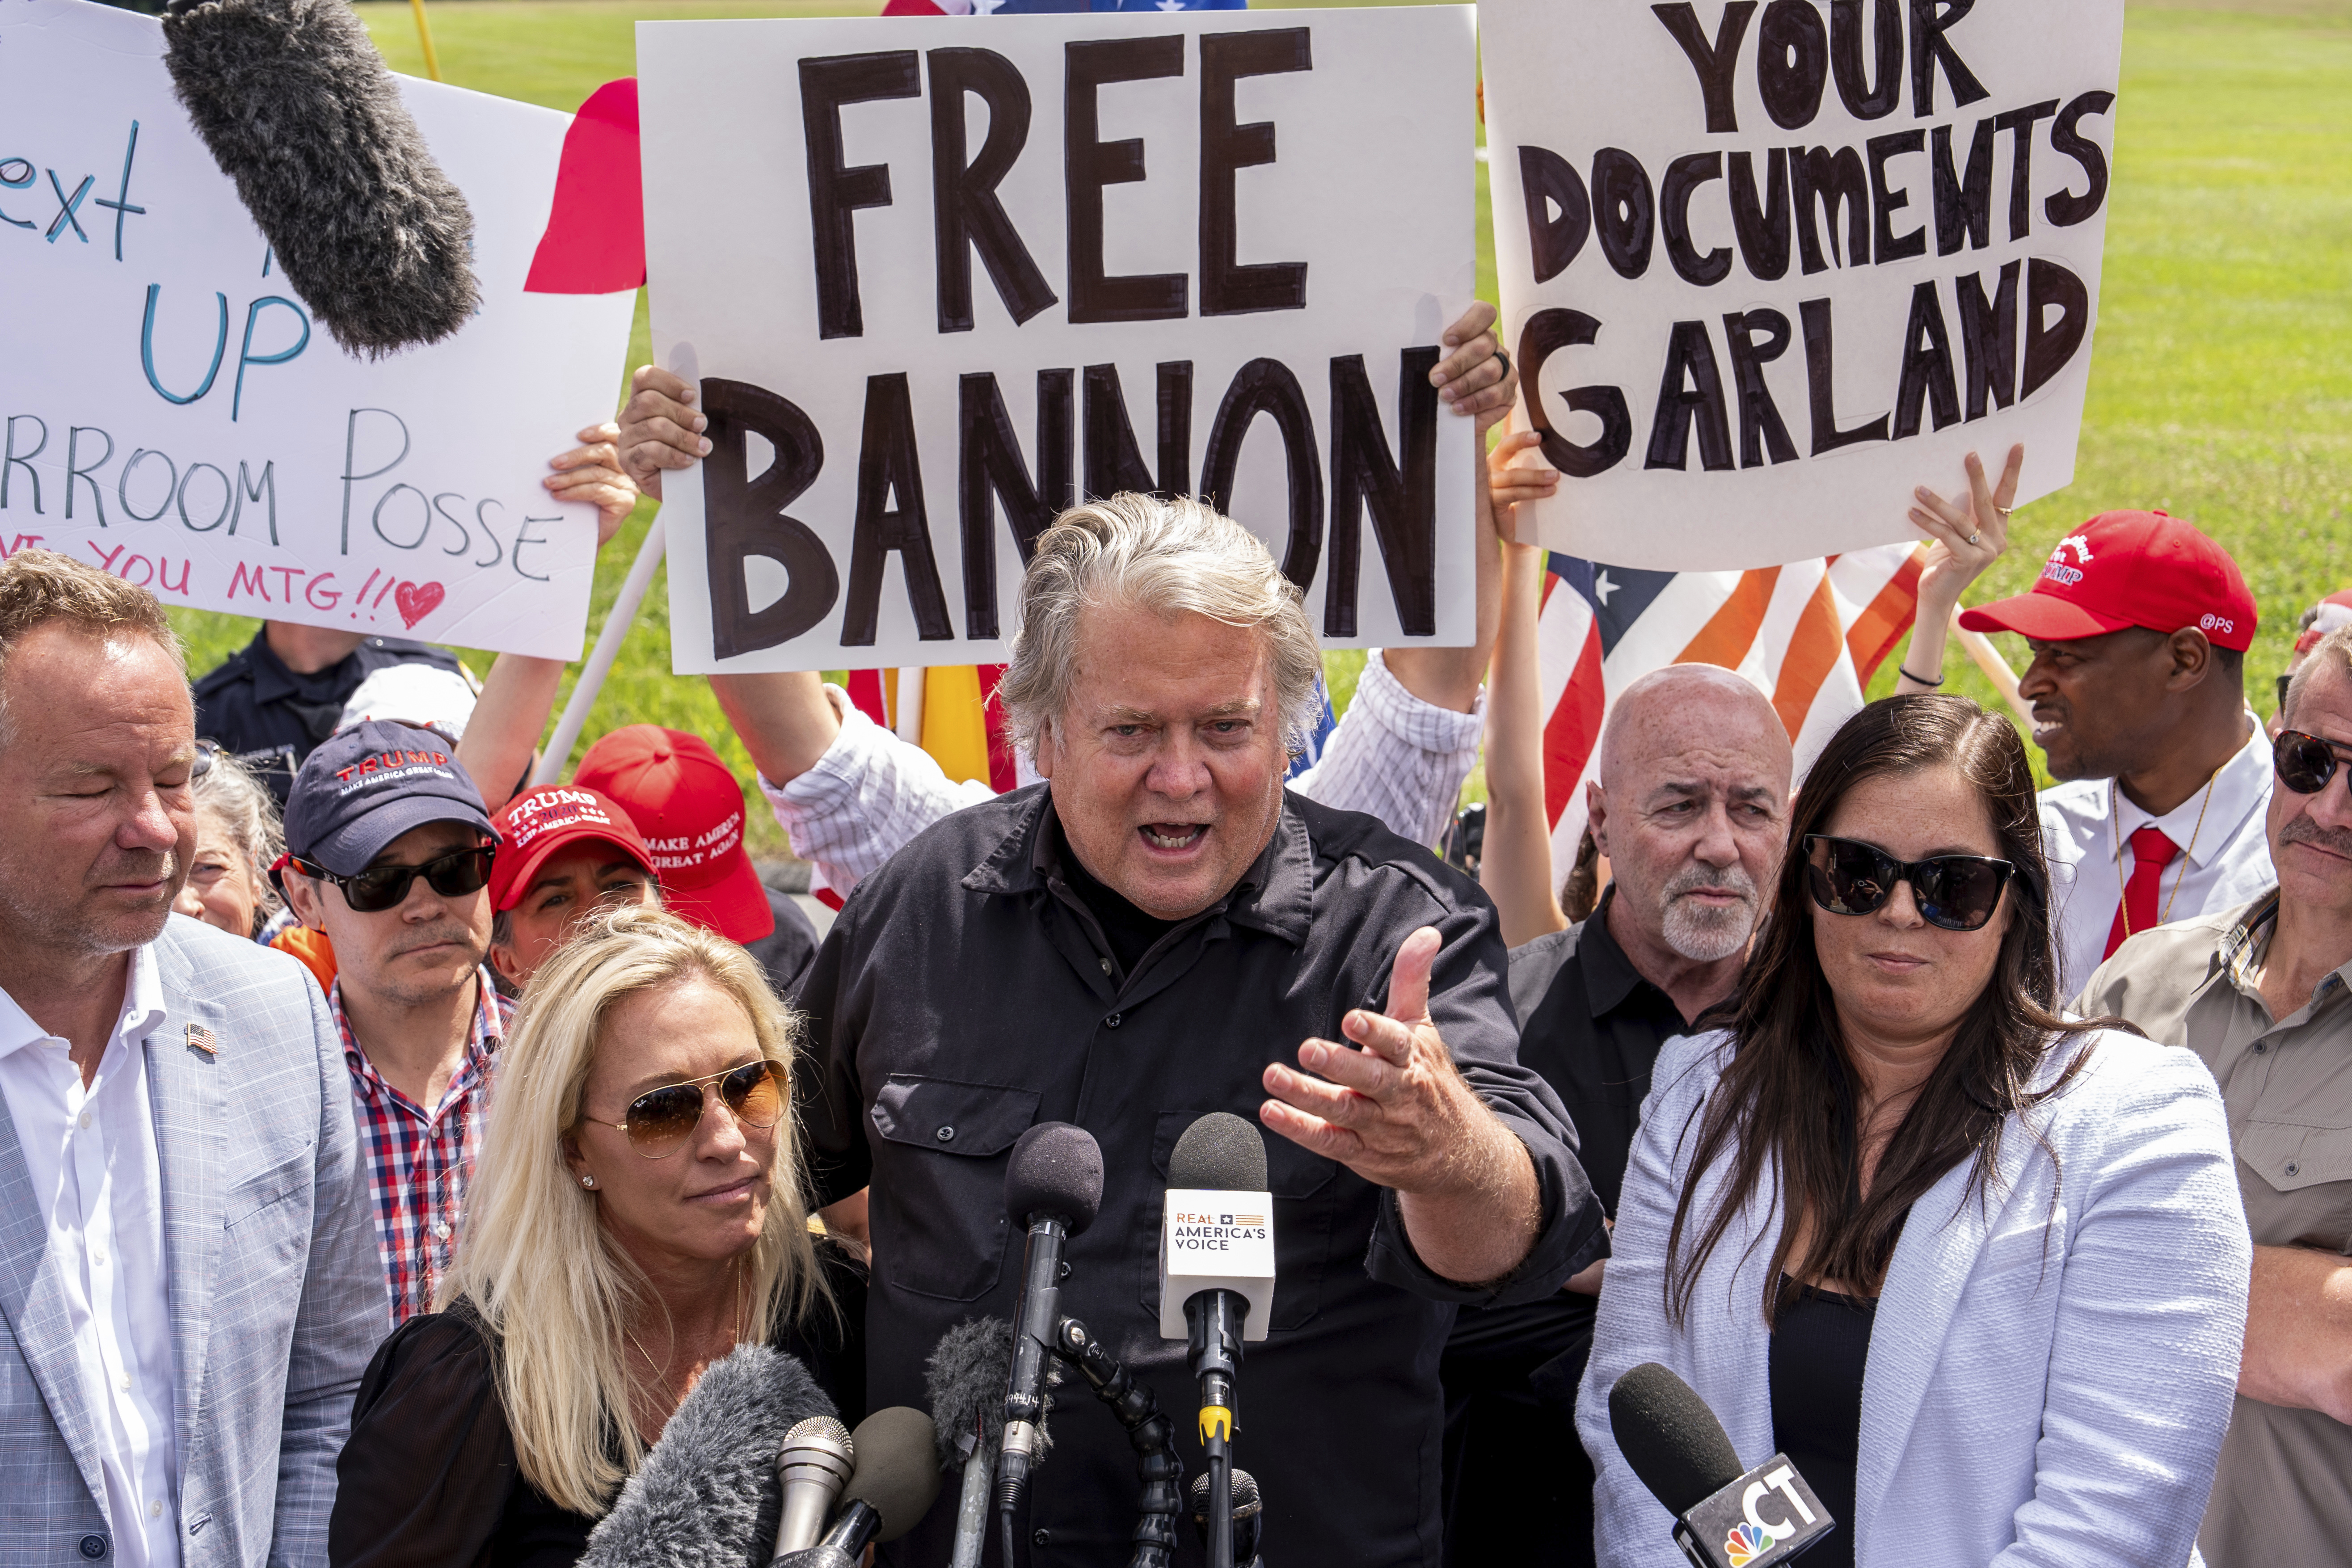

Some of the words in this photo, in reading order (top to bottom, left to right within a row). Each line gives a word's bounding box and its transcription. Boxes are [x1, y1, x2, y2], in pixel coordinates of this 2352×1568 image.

[1651, 0, 1991, 133] YOUR
[797, 27, 1313, 340] FREE
[1517, 90, 2116, 287] DOCUMENTS
[141, 282, 310, 422] UP
[1518, 258, 2089, 478] GARLAND
[341, 408, 564, 581] POSSE
[88, 540, 190, 595] YOU
[227, 561, 396, 621] MTG!!
[2200, 613, 2234, 634] @PS
[336, 750, 448, 781] TRUMP
[341, 779, 363, 796] MAKE
[364, 769, 406, 786] AMERICA
[406, 766, 433, 774] GREAT
[508, 789, 597, 827] TRUMP
[538, 814, 582, 833] AMERICA
[539, 804, 577, 822] 2020
[642, 837, 690, 851] MAKE
[695, 811, 741, 848] AMERICA
[651, 852, 704, 868] GREAT
[709, 828, 739, 860] AGAIN
[1175, 1227, 1265, 1239] AMERICA'S
[1177, 1213, 1215, 1224] REAL
[1175, 1239, 1229, 1250] VOICE
[1742, 1464, 1817, 1540] CT
